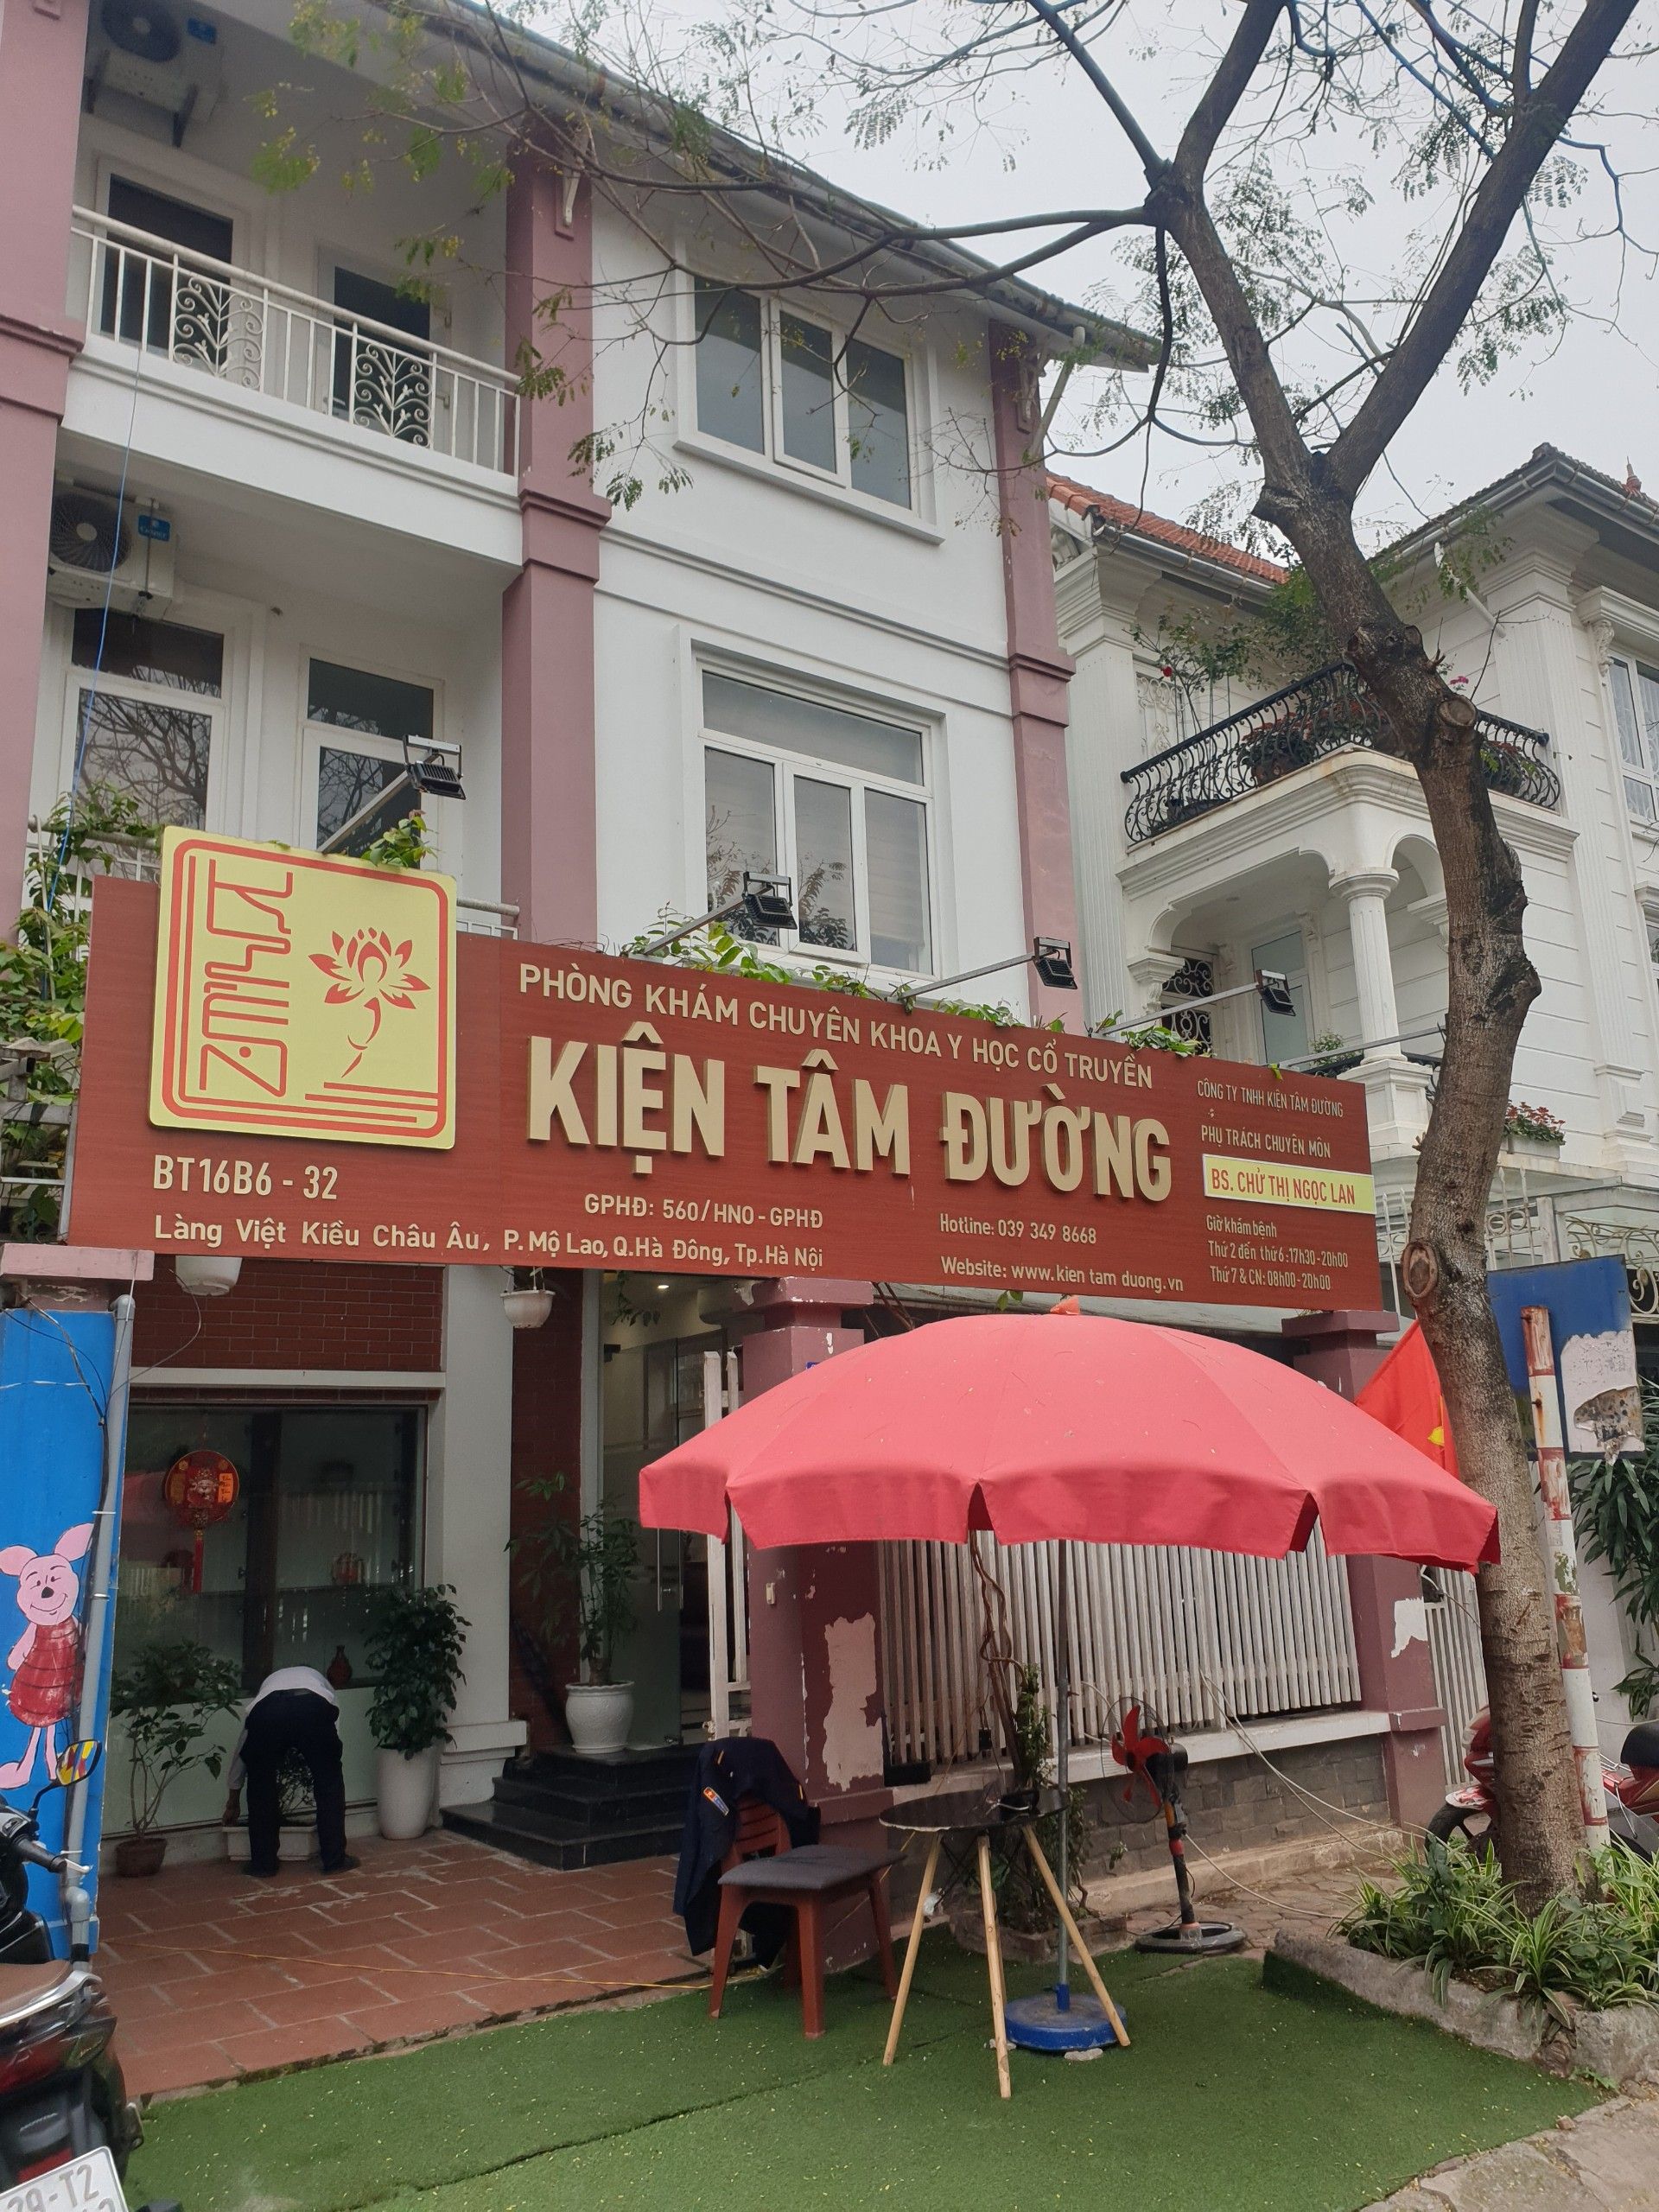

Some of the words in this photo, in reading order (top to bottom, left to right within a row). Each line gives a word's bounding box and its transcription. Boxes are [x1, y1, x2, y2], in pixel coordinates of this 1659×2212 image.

[520, 963, 632, 1008] PHÒNG
[645, 983, 738, 1026] KHÁM
[749, 1006, 860, 1044] CHUYÊN
[871, 1020, 942, 1058] KHOA
[947, 1033, 963, 1059] Y
[973, 1037, 1019, 1071] HỌC
[1027, 1039, 1058, 1074] CỔ
[1065, 1052, 1152, 1089] TRUYỀN
[527, 1021, 725, 1174] KIỆN
[753, 1049, 910, 1175] TÂM
[939, 1083, 1172, 1201] ĐƯỜNG
[1198, 1077, 1224, 1098] CÔNG
[1226, 1085, 1237, 1102] TY
[1241, 1087, 1264, 1106] TNHH
[1267, 1089, 1287, 1112] KIỆN
[1290, 1091, 1309, 1112] TÂM
[1311, 1096, 1344, 1117] ĐƯỜNG
[1201, 1124, 1222, 1147] PHỤ
[1225, 1126, 1261, 1149] TRÁCH
[1265, 1134, 1305, 1155] CHUYÊN
[1308, 1136, 1331, 1159] MÔN
[154, 1154, 271, 1196] BT16B6
[303, 1165, 338, 1199] 32
[1211, 1168, 1234, 1192] BS.
[1237, 1167, 1265, 1194] CHỬ
[1268, 1175, 1290, 1202] THỊ
[1293, 1178, 1327, 1205] NGỌC
[1331, 1182, 1355, 1205] LAN
[584, 1193, 654, 1217] GPHĐ:
[155, 1213, 222, 1248] Làng
[236, 1217, 286, 1249] Việt
[302, 1219, 359, 1246] Kiều
[372, 1224, 435, 1249] Châu
[446, 1221, 490, 1251] Âu,
[567, 1232, 608, 1258] Lao,
[672, 1238, 730, 1266] Đông,
[795, 1247, 823, 1271] Nội
[940, 1213, 995, 1236] Hotline:
[998, 1218, 1025, 1238] 039
[1030, 1222, 1056, 1241] 349
[1062, 1225, 1096, 1244] 8668
[1206, 1214, 1224, 1231] Giờ
[1224, 1217, 1252, 1236] khám
[1253, 1220, 1277, 1239] bệnh
[941, 1255, 1007, 1278] Website:
[1208, 1240, 1228, 1257] Thứ
[1230, 1243, 1236, 1259] 2
[1238, 1242, 1256, 1261] đến
[1260, 1245, 1279, 1262] thứ
[1210, 1265, 1230, 1283] Thứ
[1230, 1268, 1237, 1283] 7
[1239, 1268, 1247, 1284] &
